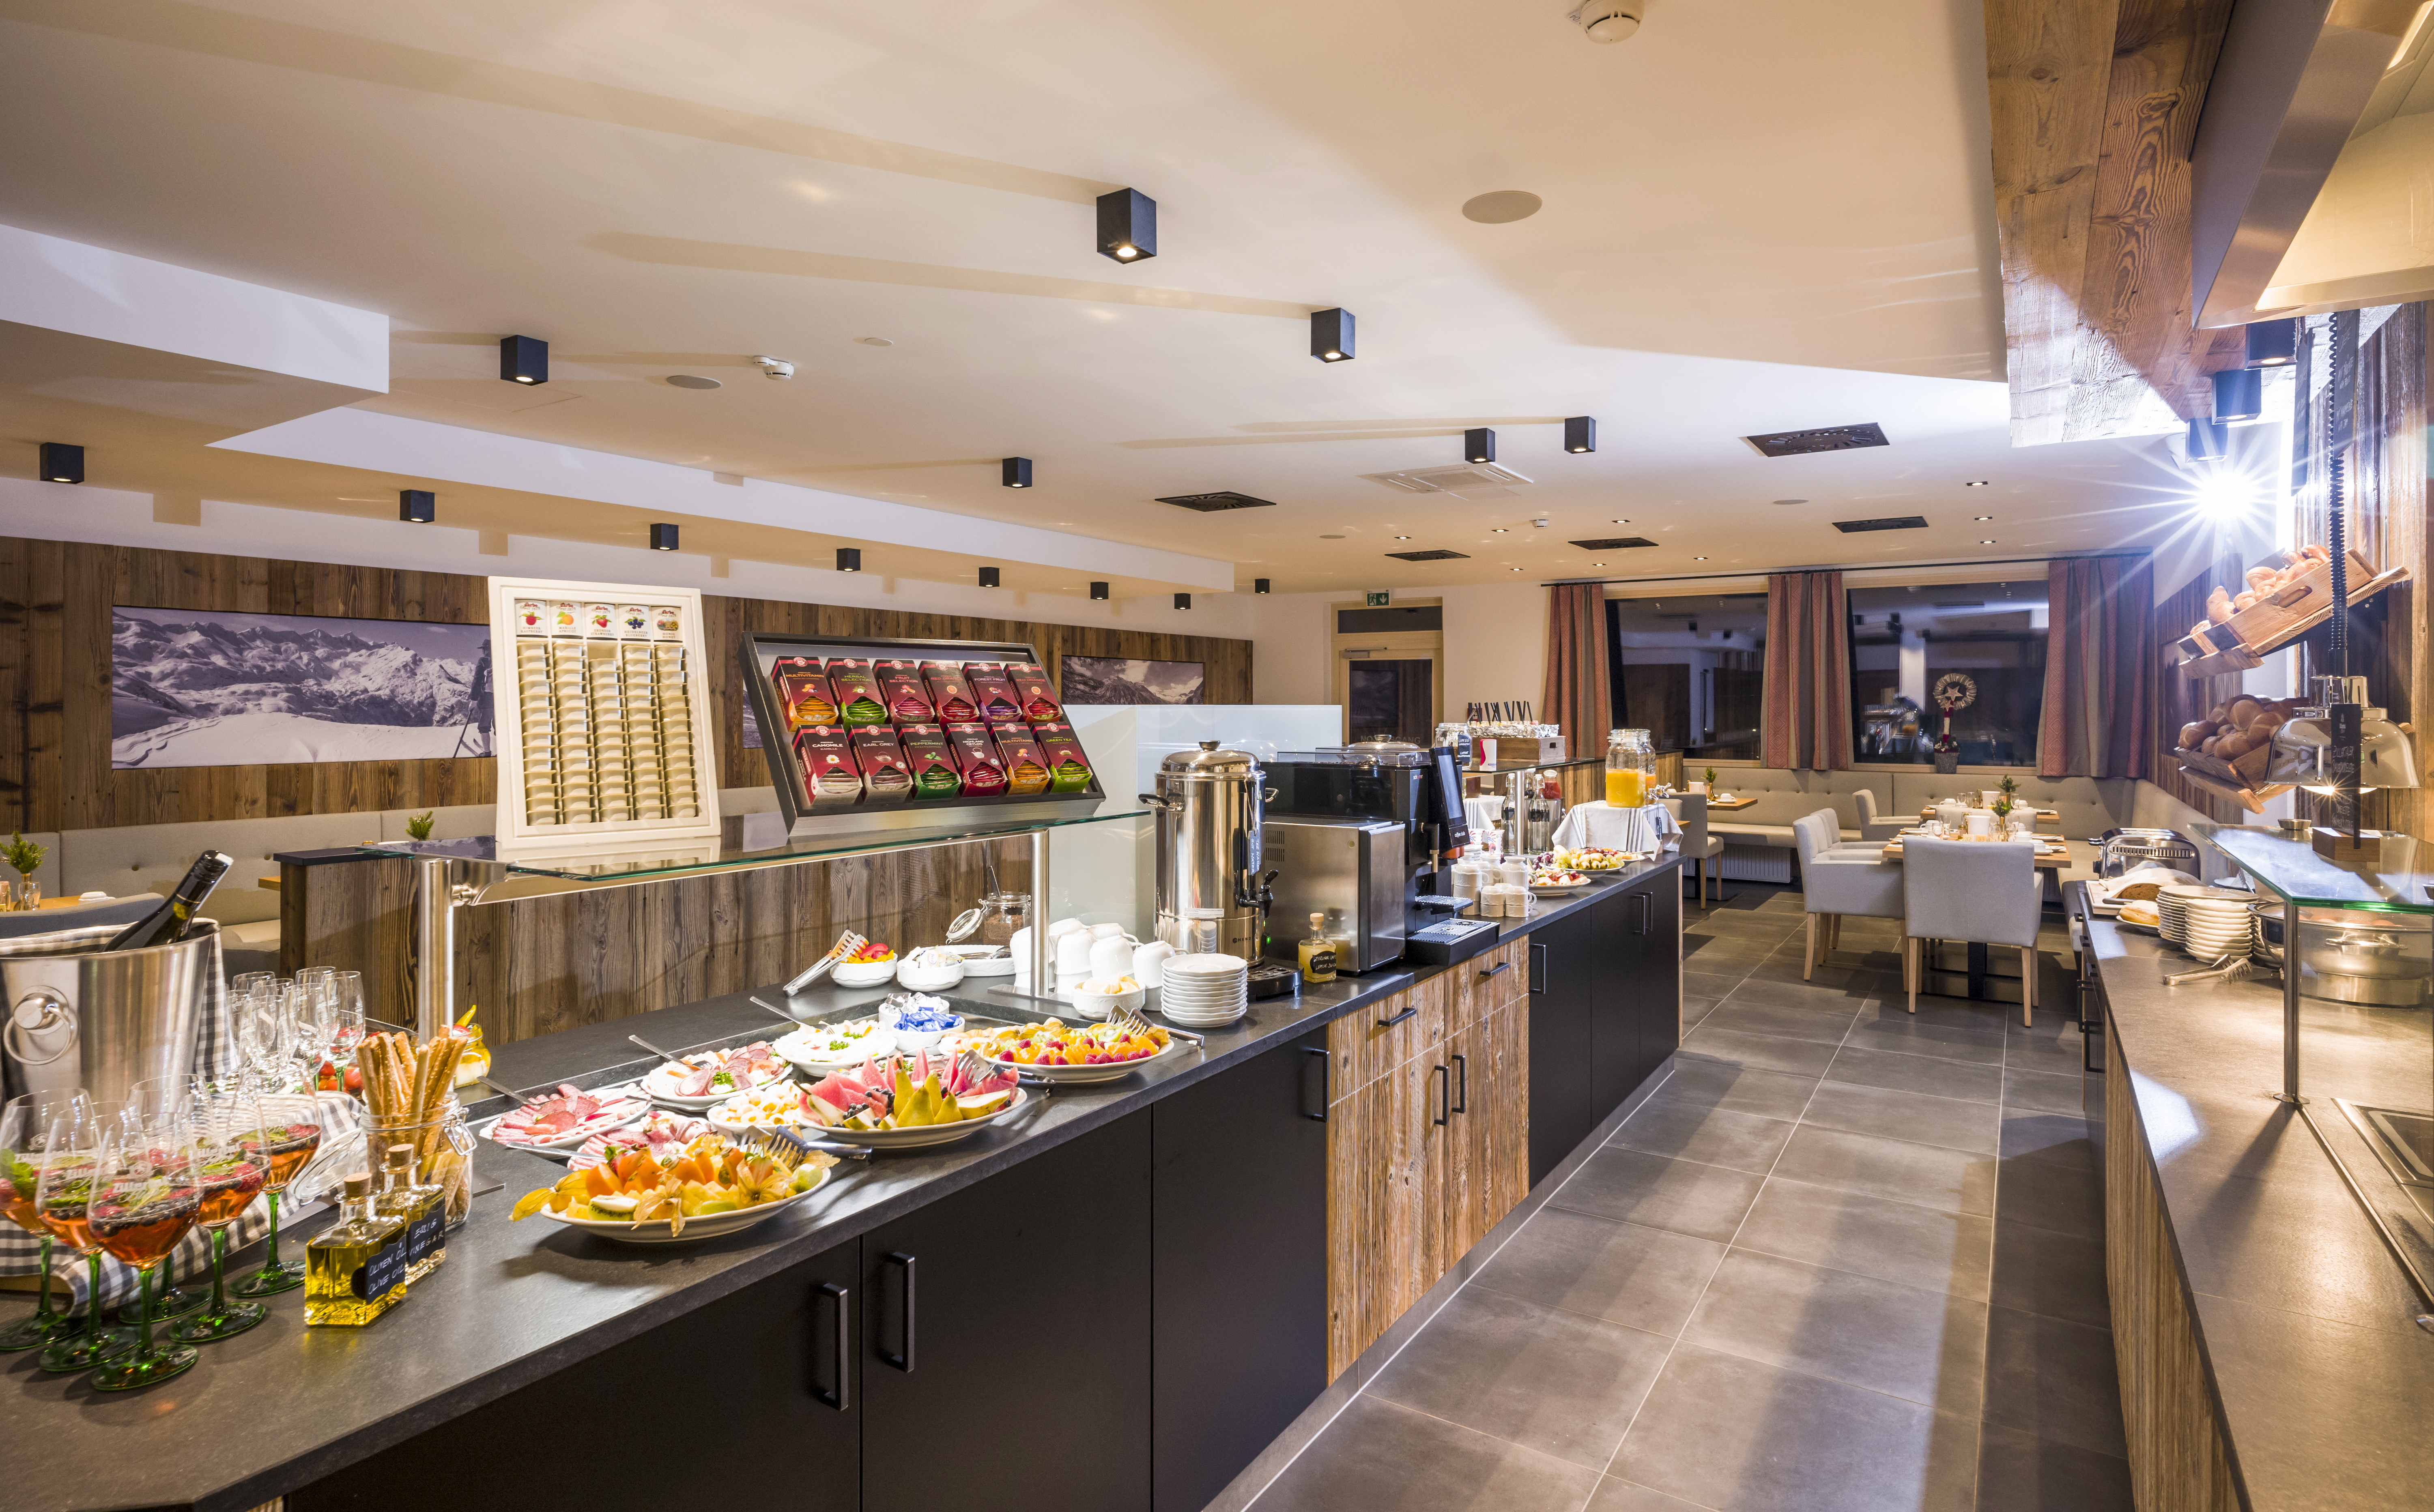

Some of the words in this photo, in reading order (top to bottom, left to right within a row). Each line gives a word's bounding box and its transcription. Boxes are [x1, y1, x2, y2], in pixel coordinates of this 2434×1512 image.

[1010, 682, 1020, 702] TEEKANNE
[950, 745, 961, 768] TEEKANNE
[996, 743, 1006, 767] TEEKANNE
[1038, 743, 1049, 765] TEEKANNE
[112, 1176, 168, 1193] Zillertal
[409, 1231, 444, 1256] VINEGAR
[369, 1254, 394, 1276] OLIVEN
[368, 1274, 390, 1294] OLIVE
[392, 1264, 405, 1278] OIL
